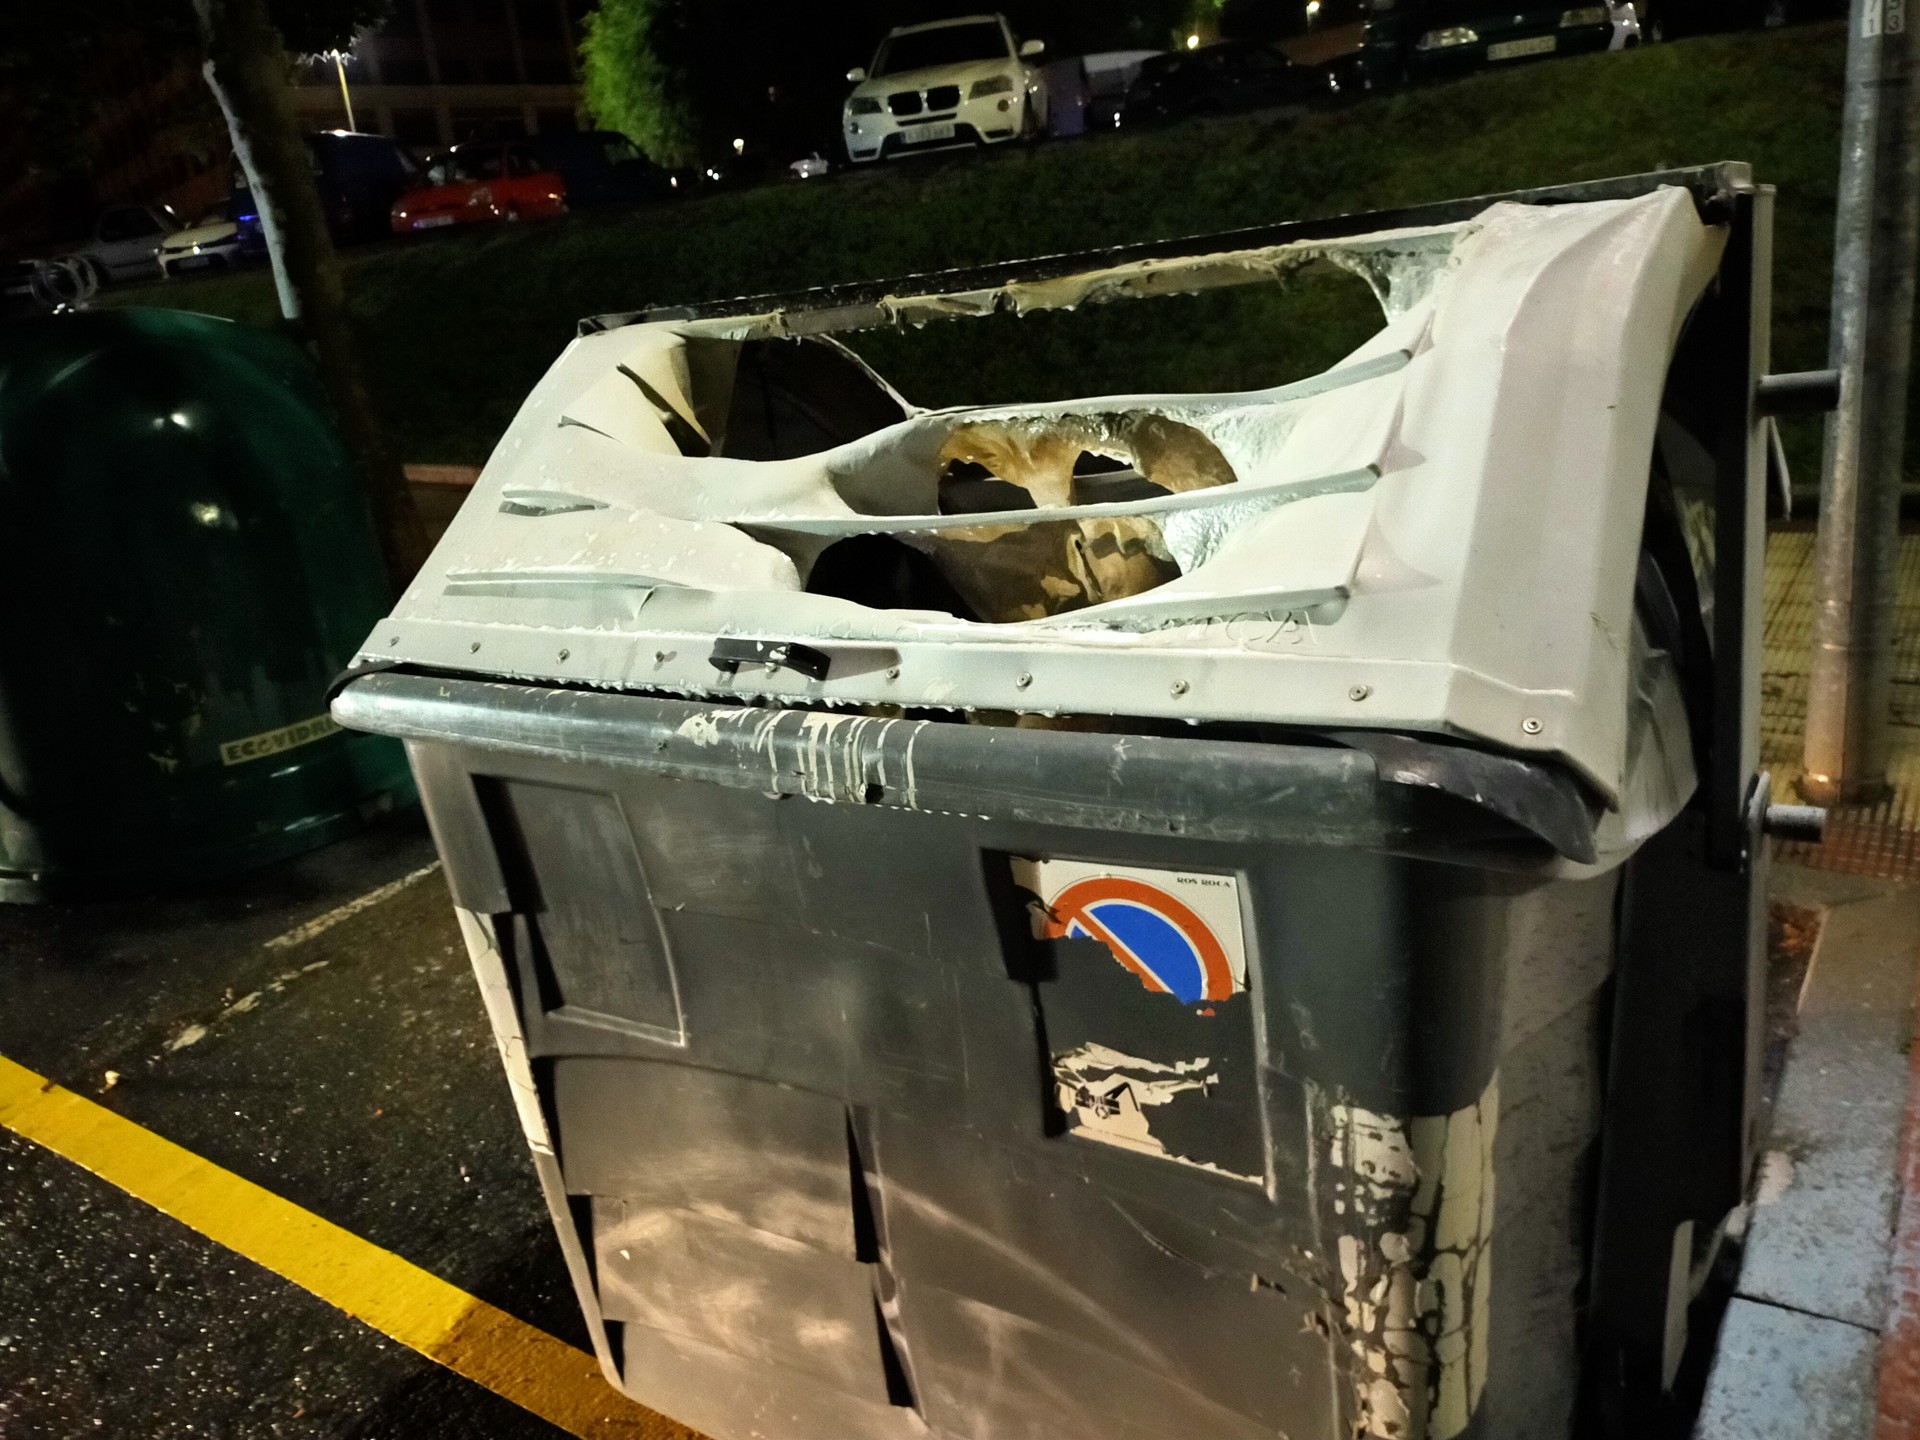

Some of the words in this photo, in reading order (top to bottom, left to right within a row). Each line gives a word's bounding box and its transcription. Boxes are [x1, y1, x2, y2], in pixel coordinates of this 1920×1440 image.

[226, 717, 337, 761] ECOVIDRI
[1176, 876, 1198, 885] ROS
[1201, 878, 1231, 889] ROCA
